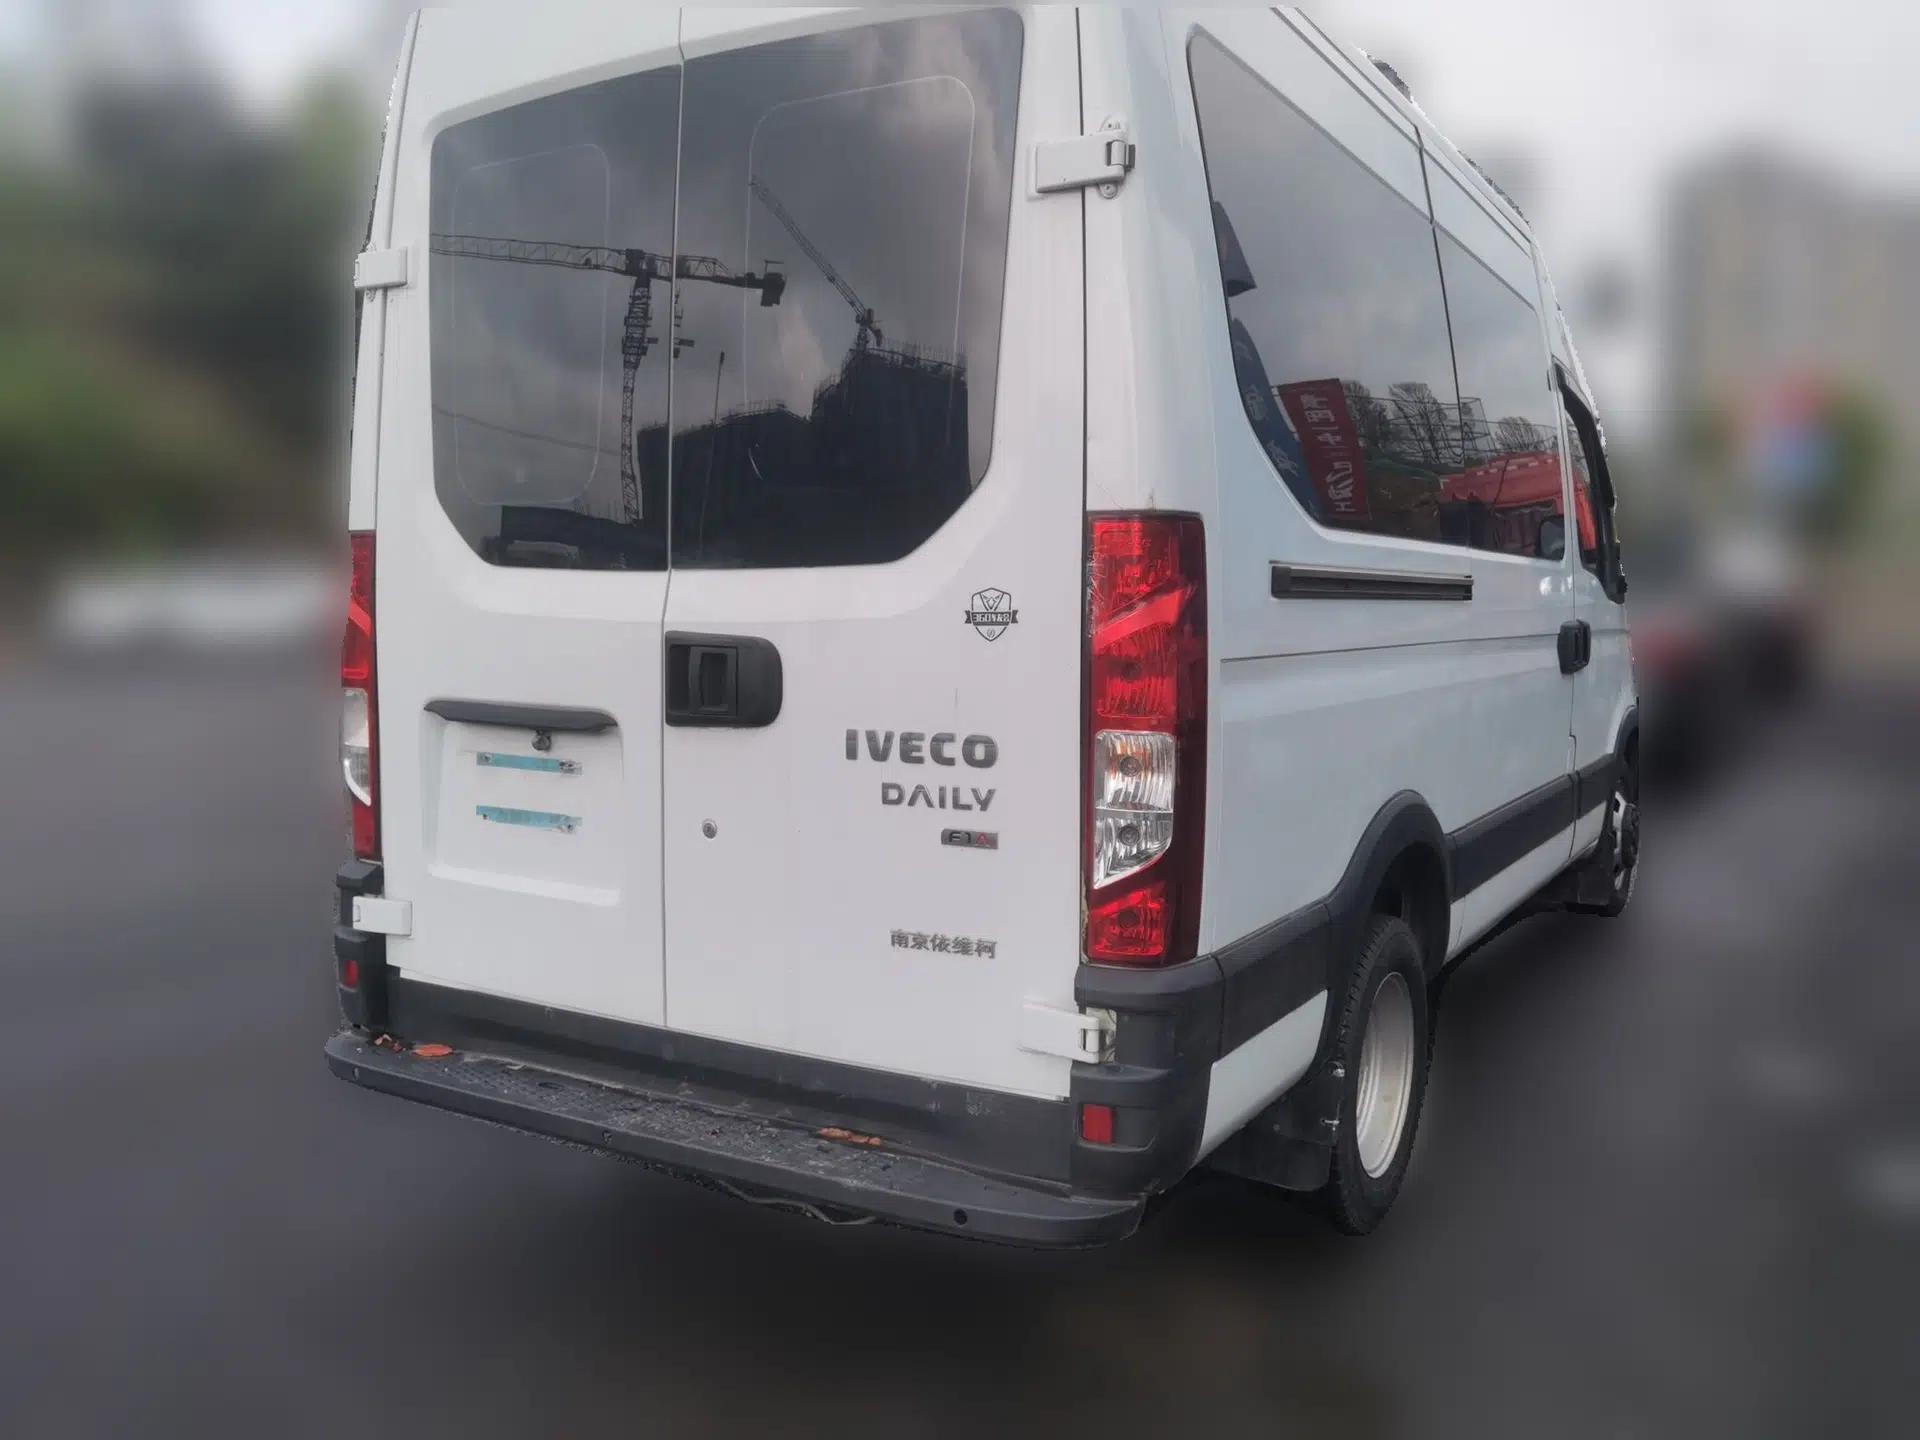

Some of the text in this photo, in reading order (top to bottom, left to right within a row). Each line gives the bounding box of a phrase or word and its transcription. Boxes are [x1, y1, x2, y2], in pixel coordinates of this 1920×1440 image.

[845, 729, 999, 768] IVECO
[881, 782, 996, 811] DAILY
[889, 928, 998, 959] 南京依维柯
